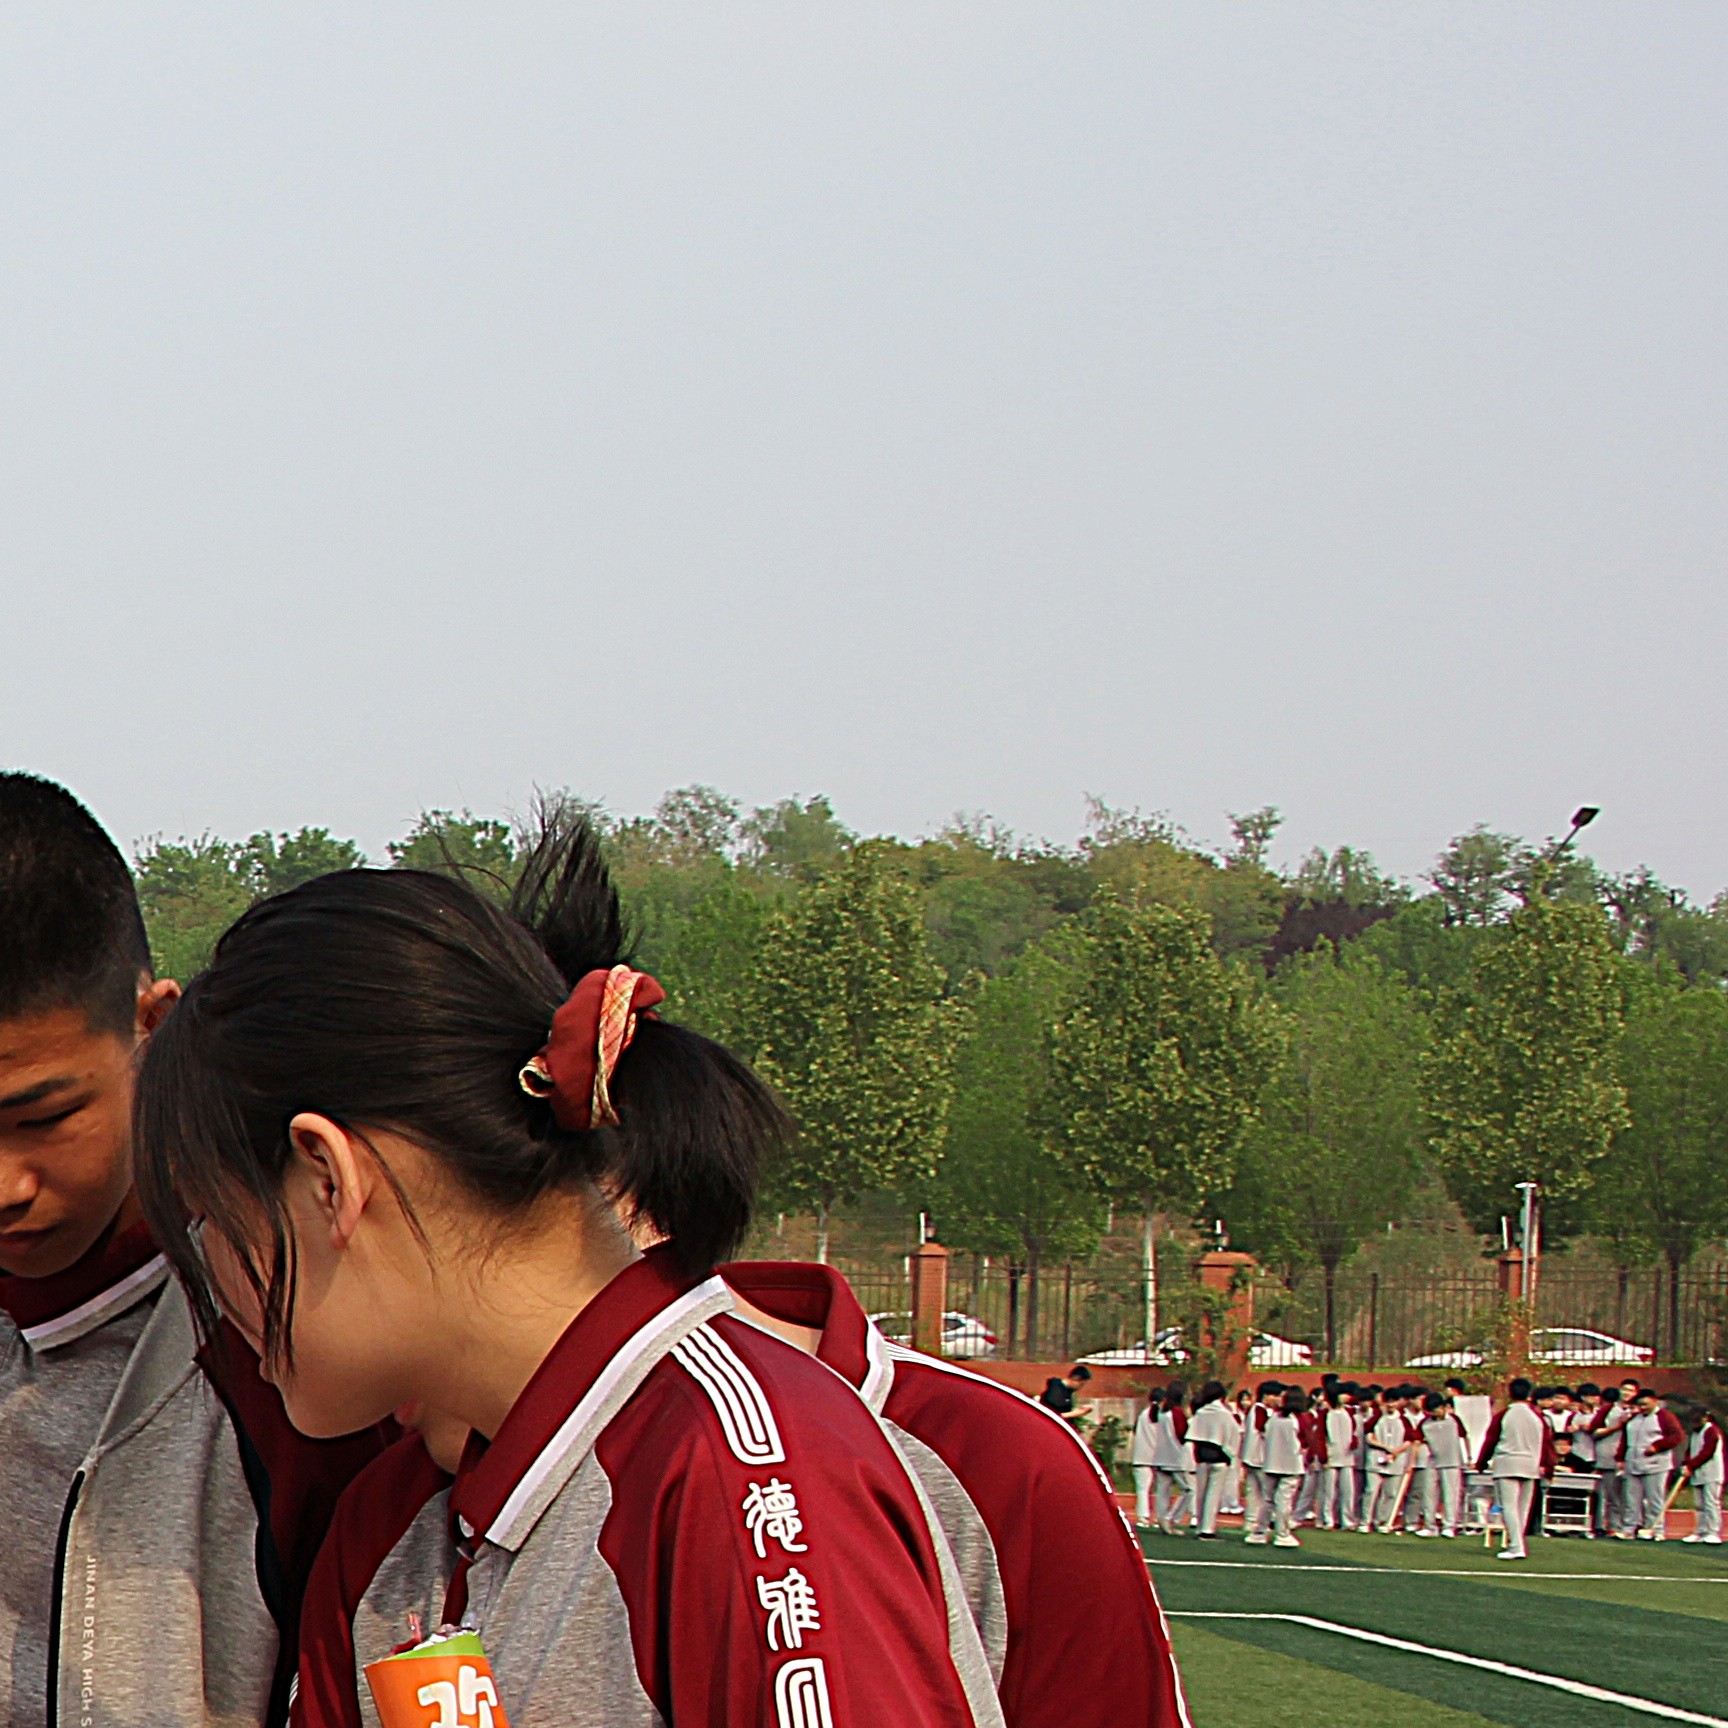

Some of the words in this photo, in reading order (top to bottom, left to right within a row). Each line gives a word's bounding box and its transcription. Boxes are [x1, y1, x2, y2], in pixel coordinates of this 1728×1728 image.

[84, 1555, 96, 1605] JINAN
[81, 1616, 95, 1661] DEYA
[81, 1668, 94, 1711] HIGH
